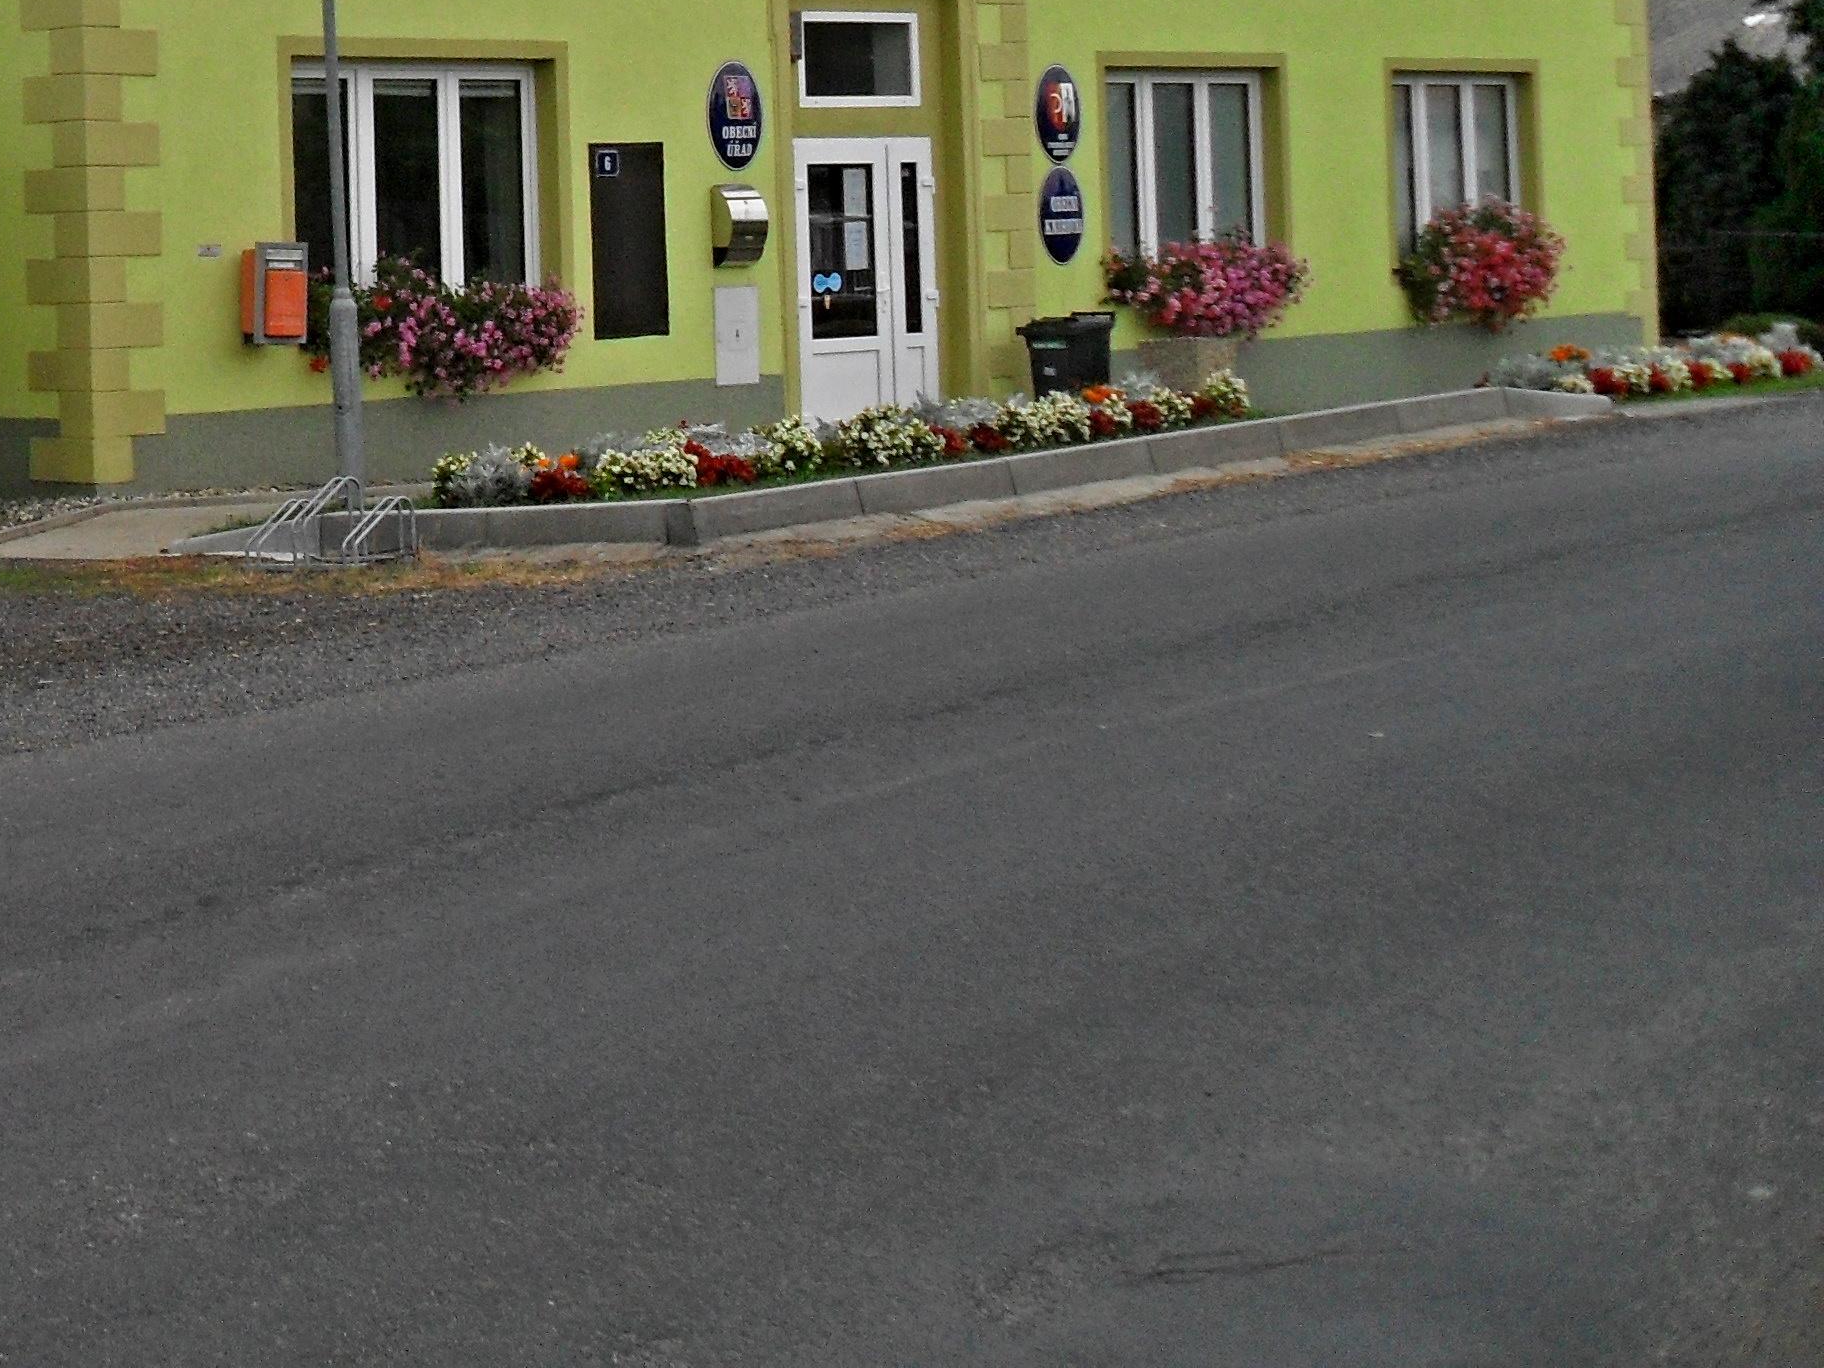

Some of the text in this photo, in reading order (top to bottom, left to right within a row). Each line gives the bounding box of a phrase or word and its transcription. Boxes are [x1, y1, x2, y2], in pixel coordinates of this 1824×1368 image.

[722, 122, 756, 139] OBECNÍ
[727, 140, 753, 157] ÚŘAD
[604, 155, 612, 171] 6
